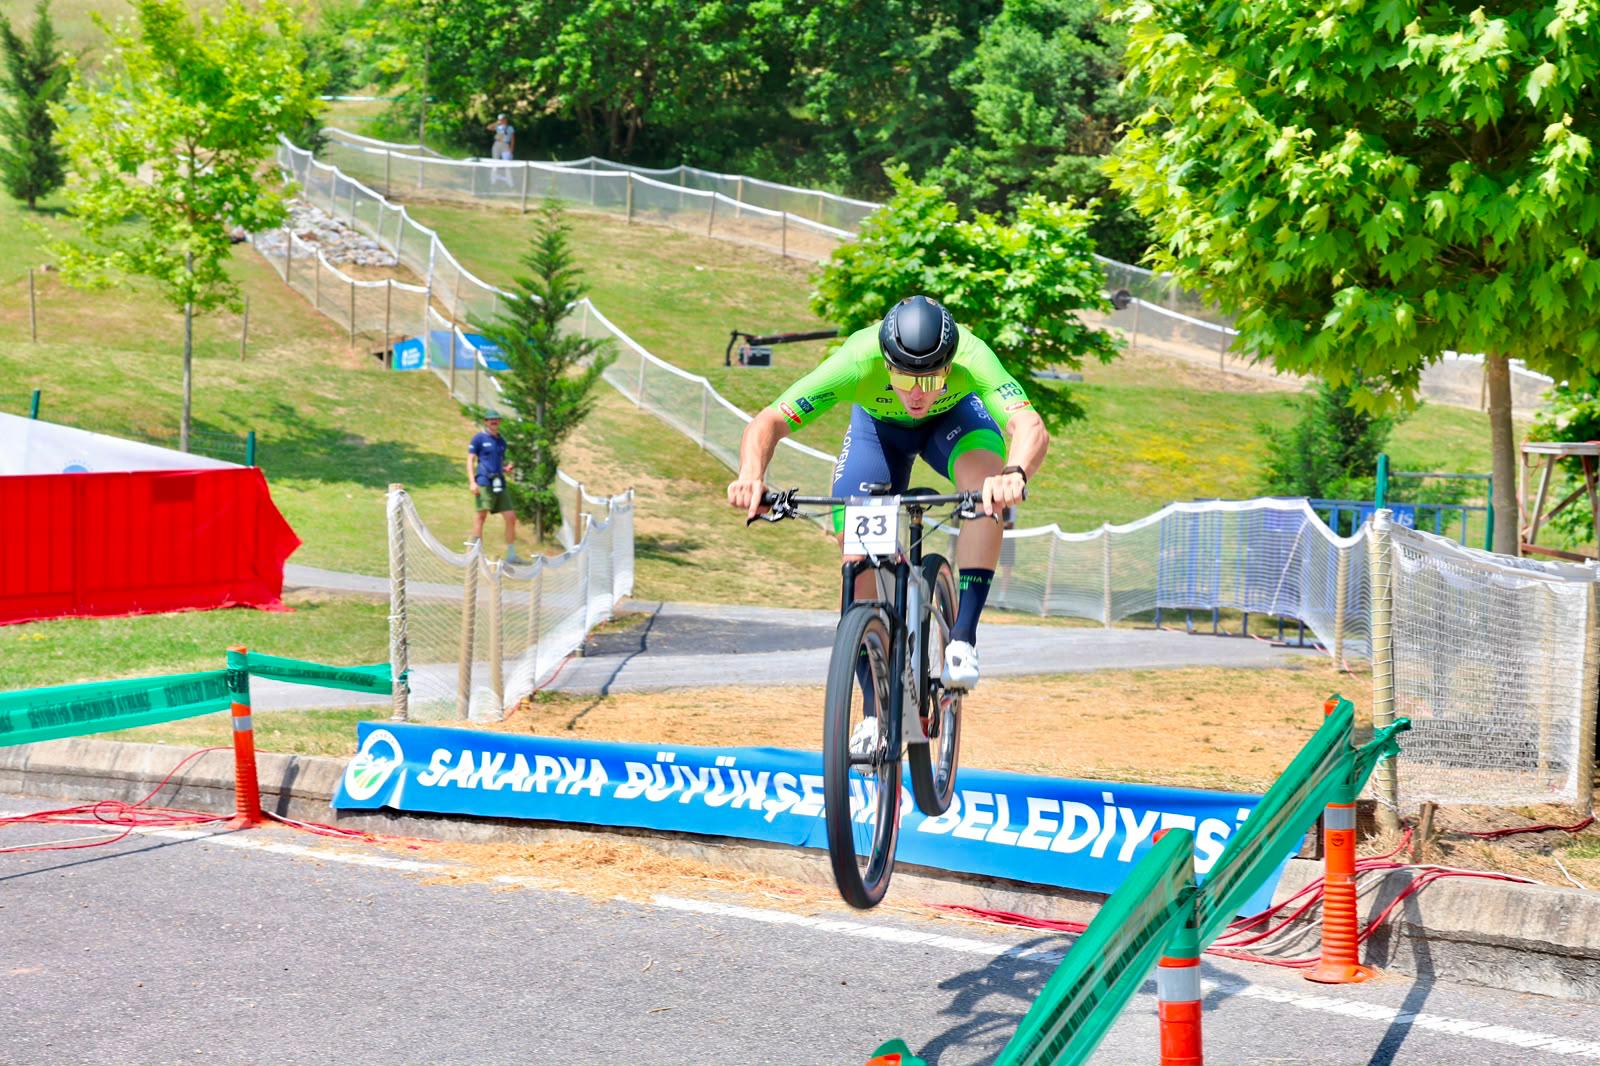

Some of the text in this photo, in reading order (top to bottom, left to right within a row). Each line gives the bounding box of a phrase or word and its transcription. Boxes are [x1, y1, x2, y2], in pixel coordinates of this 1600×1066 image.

[833, 424, 852, 484] LOVENIA
[855, 515, 888, 536] 33
[416, 748, 609, 797] SAKARYA
[917, 791, 1252, 875] BELEDİYS
